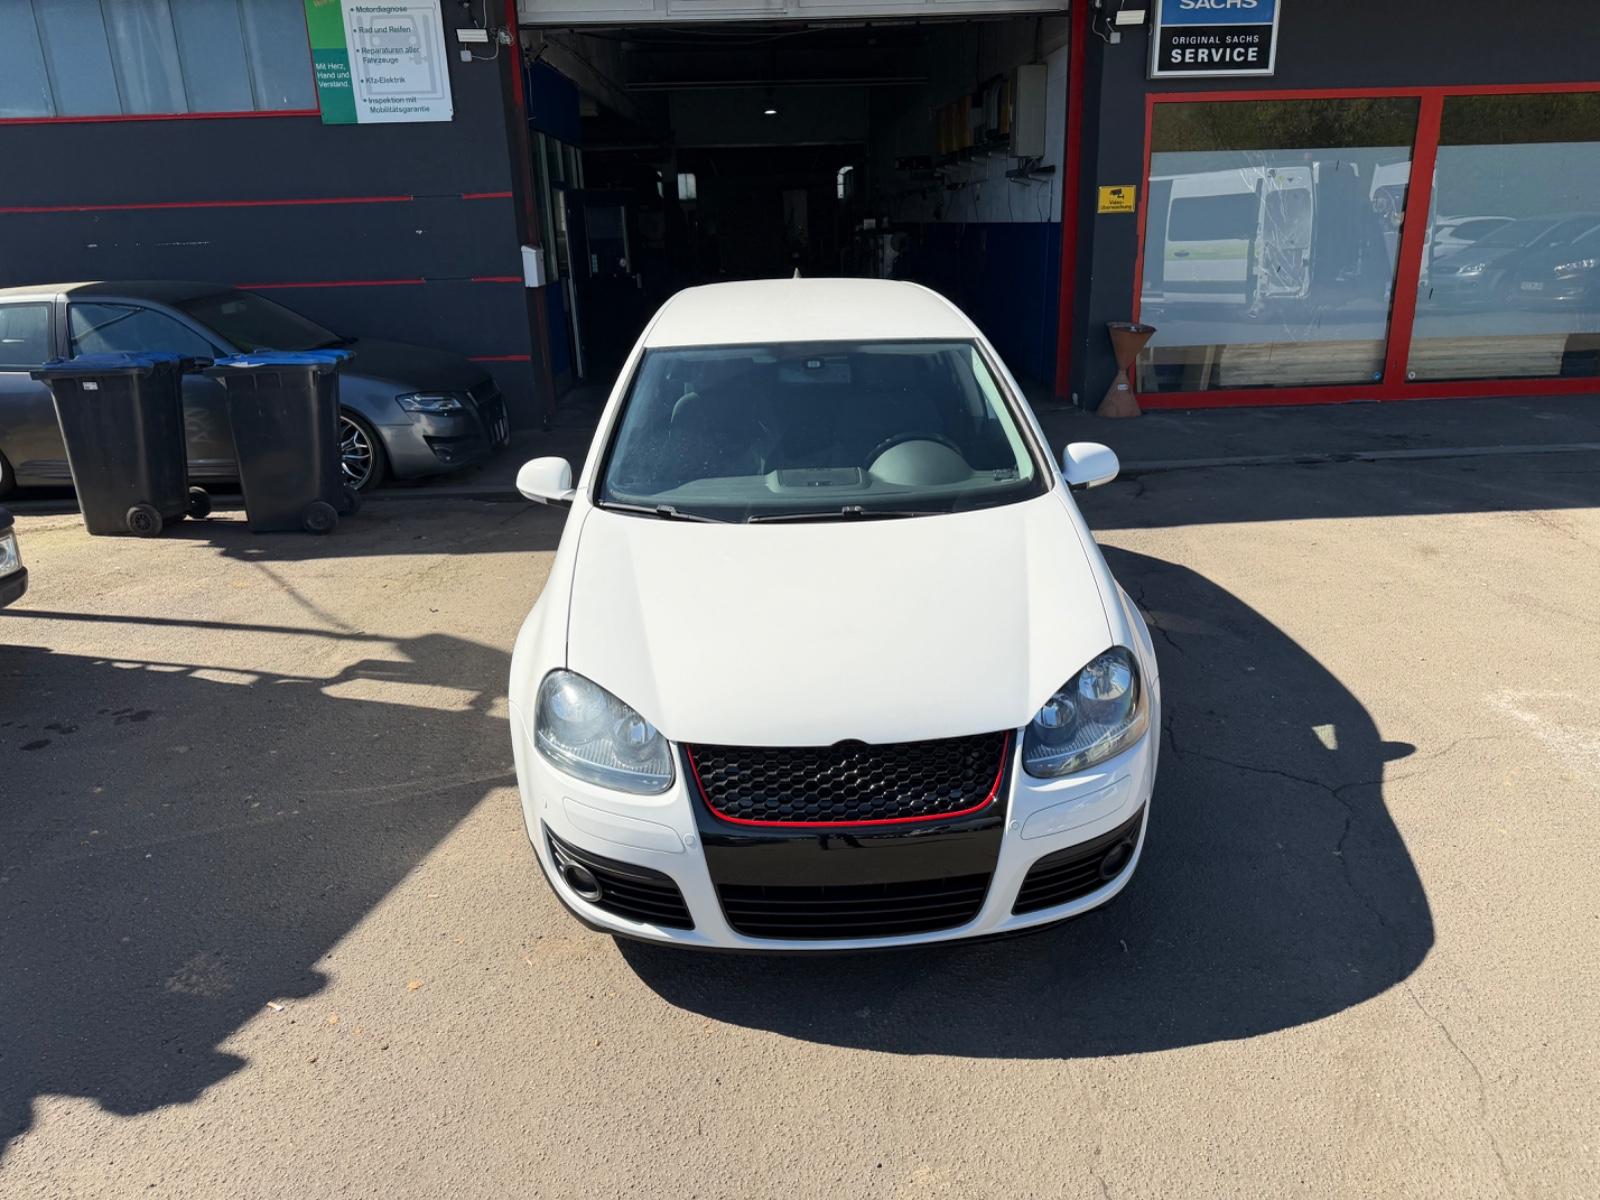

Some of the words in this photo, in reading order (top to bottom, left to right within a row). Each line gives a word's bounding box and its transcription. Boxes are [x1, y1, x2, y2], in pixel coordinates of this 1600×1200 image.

[1180, 0, 1258, 9] SACHS
[1172, 36, 1221, 45] ORIGINAL
[1226, 35, 1259, 43] SACHS
[1171, 47, 1258, 63] SERVICE
